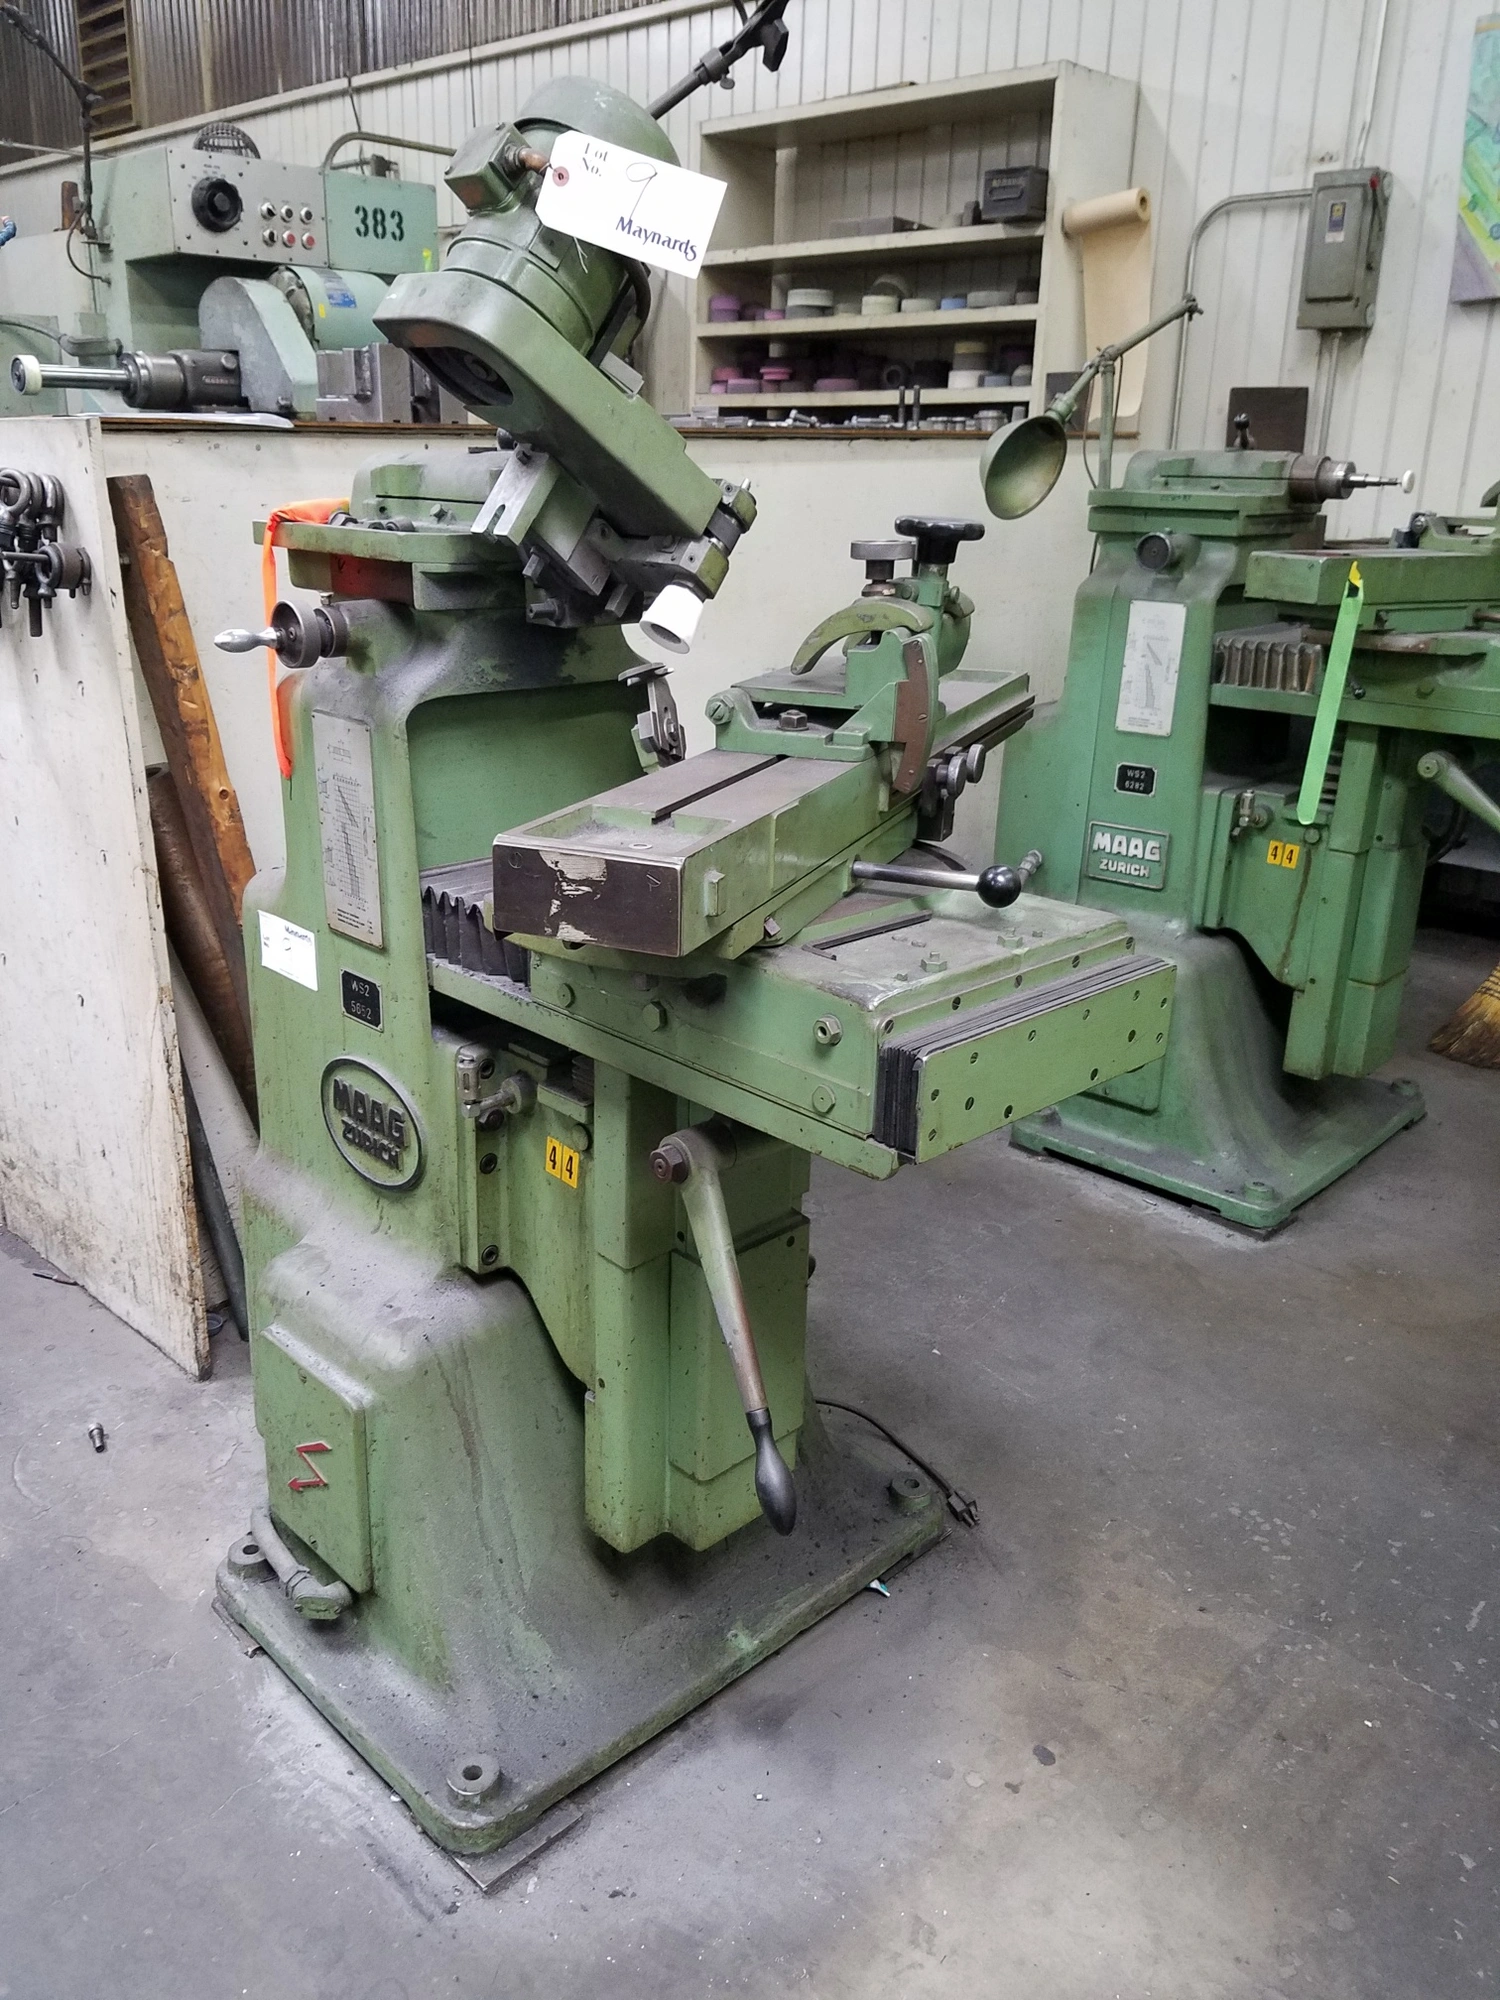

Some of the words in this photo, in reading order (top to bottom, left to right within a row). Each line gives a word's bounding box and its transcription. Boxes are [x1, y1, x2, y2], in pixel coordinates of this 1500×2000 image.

[354, 204, 405, 242] 383
[615, 215, 698, 262] Maynards
[1093, 831, 1161, 861] MAAG
[1099, 858, 1151, 878] ZURICH
[332, 1076, 407, 1149] MAAG
[341, 1116, 403, 1172] ZURICH
